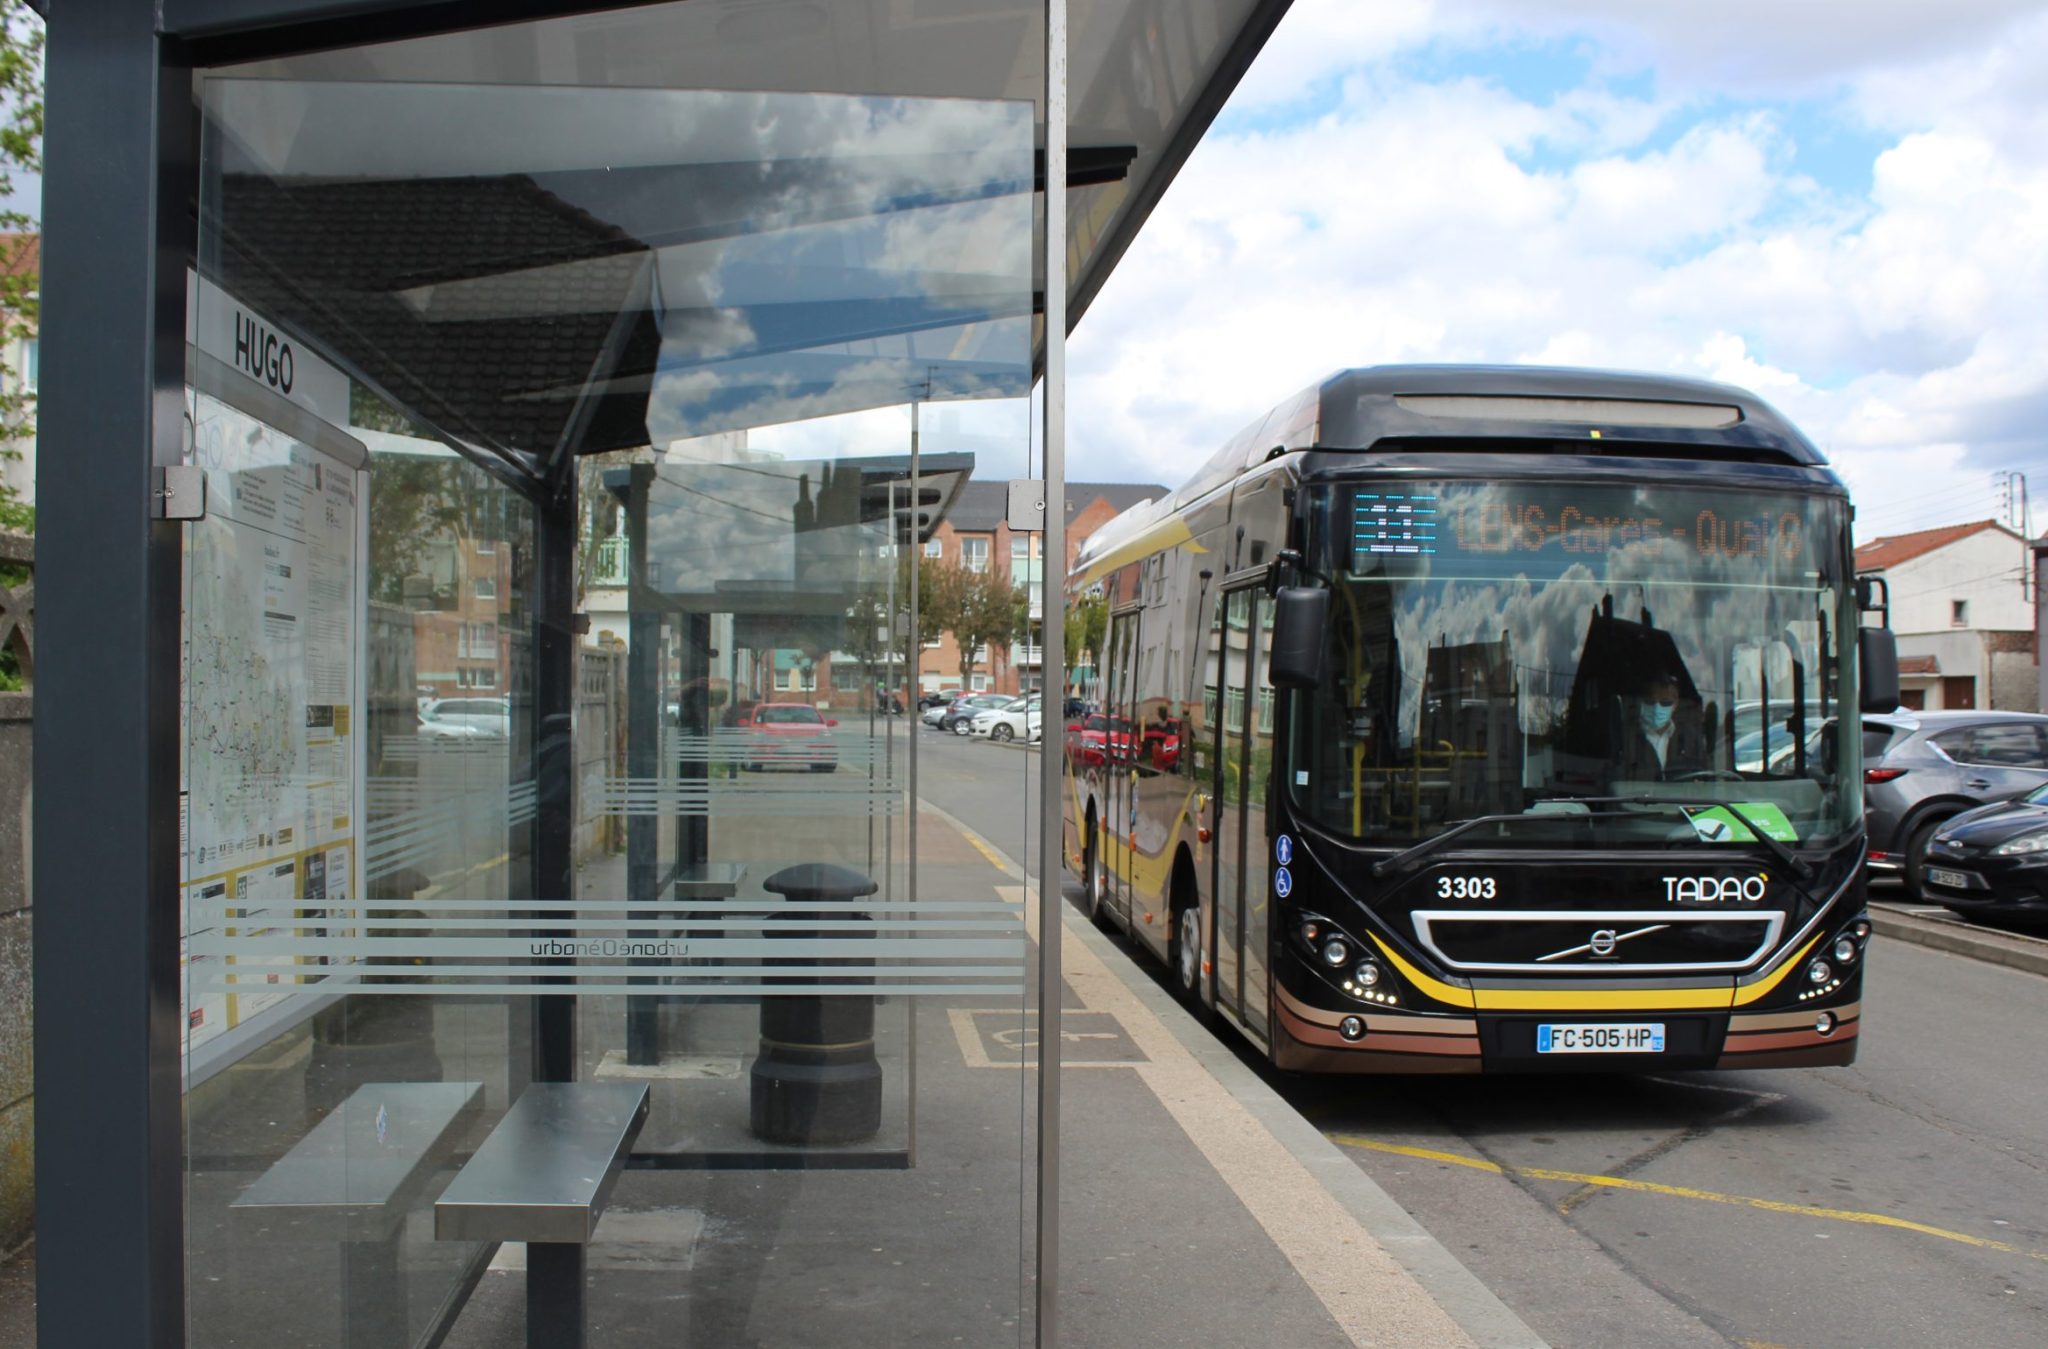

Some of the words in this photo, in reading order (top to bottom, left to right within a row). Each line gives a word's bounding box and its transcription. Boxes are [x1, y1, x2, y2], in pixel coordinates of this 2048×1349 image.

[236, 311, 294, 395] HUGO
[1456, 503, 1663, 555] LENS-Gares
[1696, 510, 1769, 558] Quai
[1438, 876, 1497, 899] 3303
